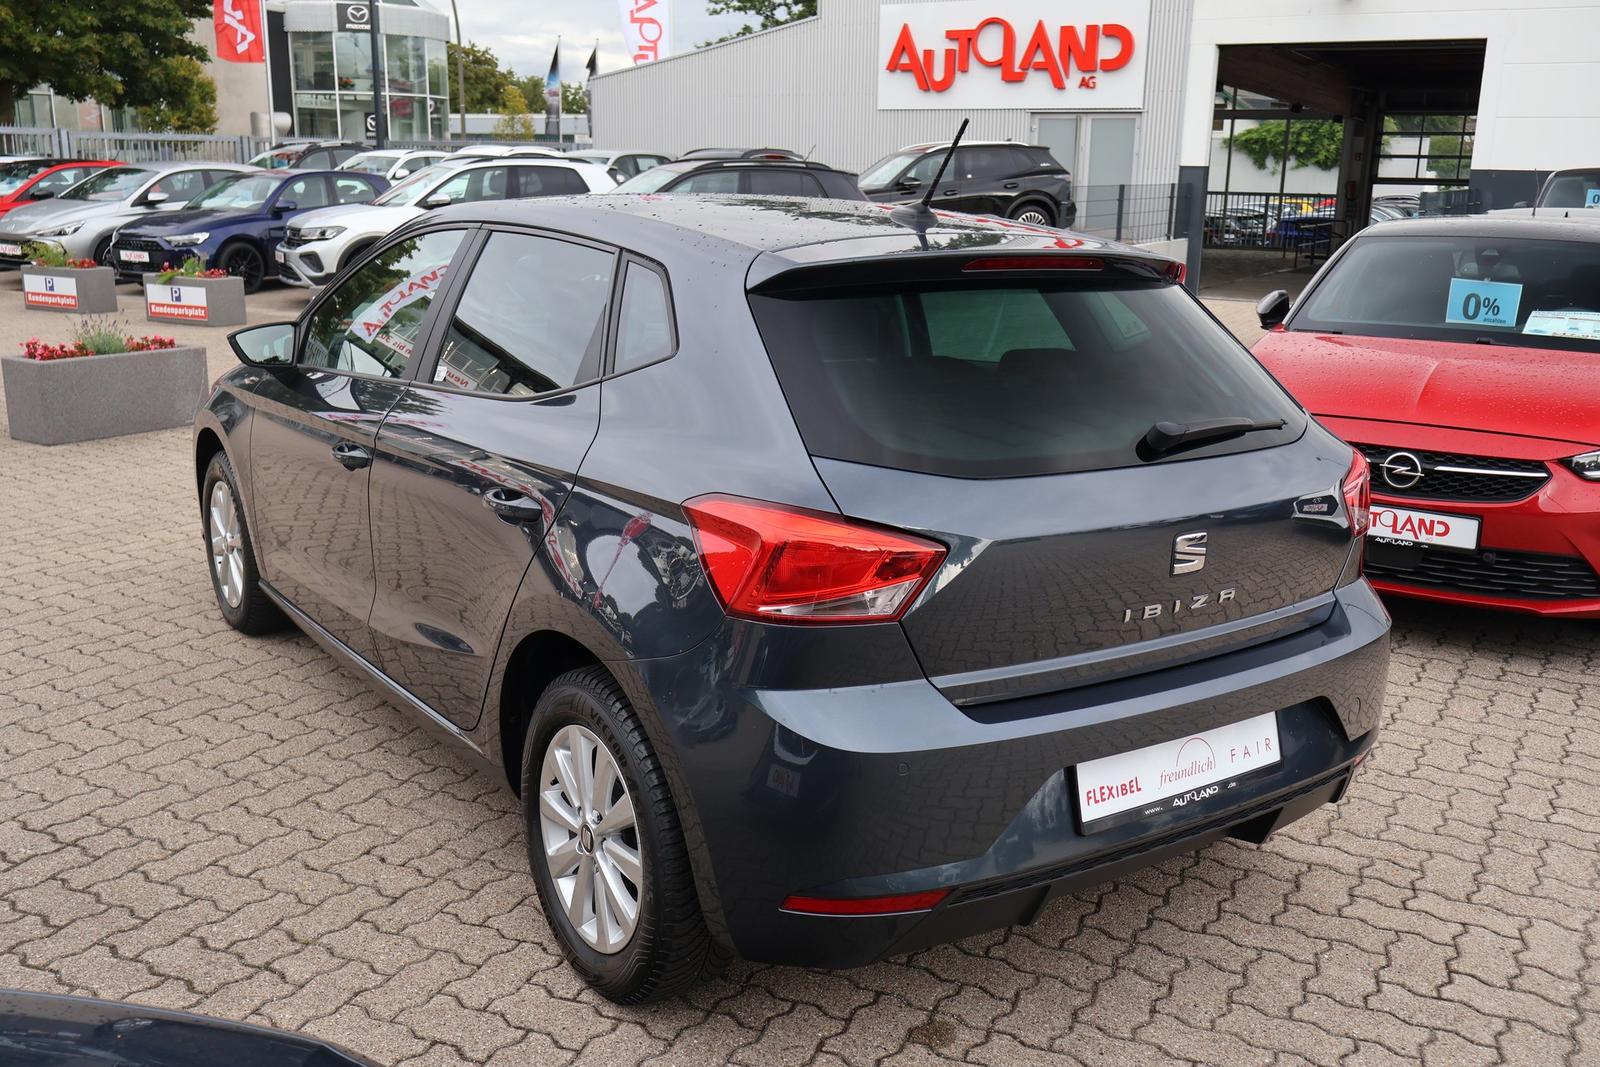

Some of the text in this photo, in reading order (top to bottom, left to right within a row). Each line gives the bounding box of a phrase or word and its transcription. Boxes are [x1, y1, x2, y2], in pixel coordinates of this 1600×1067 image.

[886, 16, 1135, 93] AUTOLAND
[1078, 75, 1097, 90] AG
[151, 304, 206, 317] Kundenparkplatz
[1462, 292, 1501, 321] 0%
[1370, 509, 1452, 541] TOLAND
[1122, 588, 1236, 624] IBIZA
[1086, 737, 1273, 807] FLEXIBEL freundlich FAIR
[1172, 785, 1220, 807] AUTOLAND
